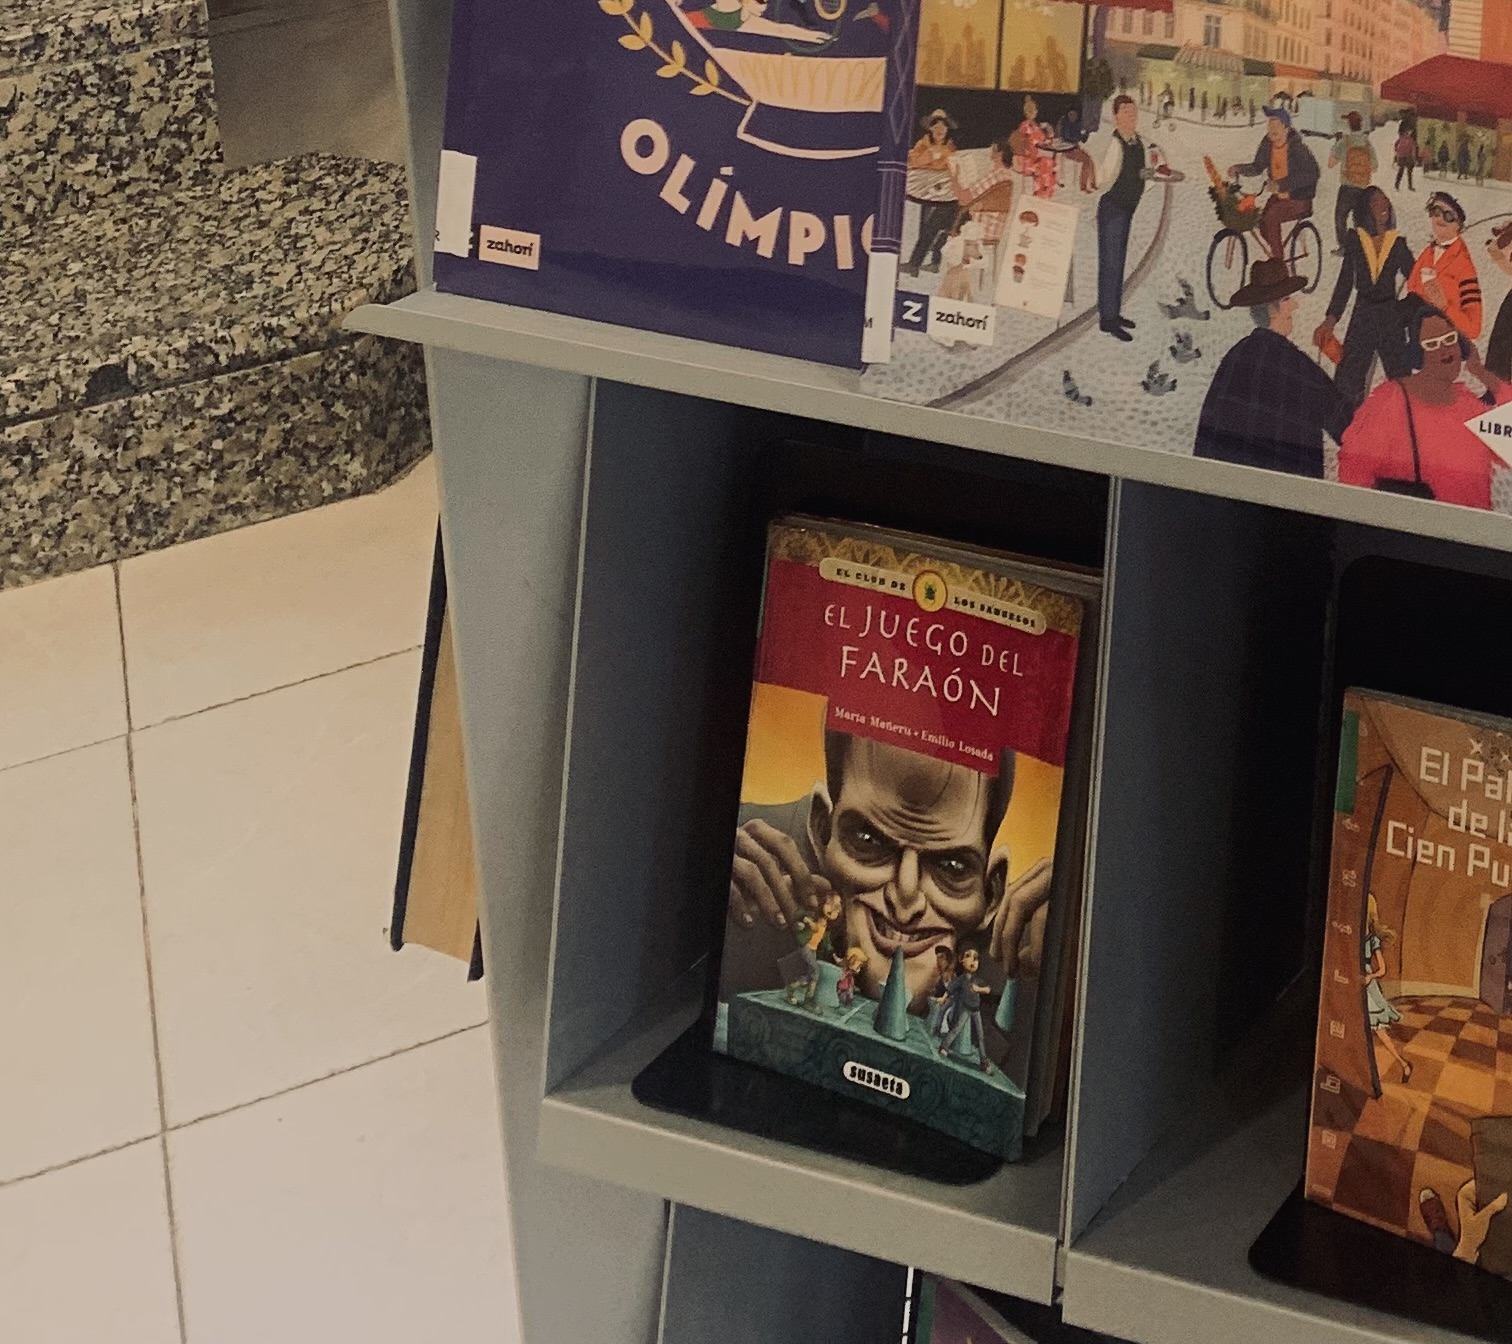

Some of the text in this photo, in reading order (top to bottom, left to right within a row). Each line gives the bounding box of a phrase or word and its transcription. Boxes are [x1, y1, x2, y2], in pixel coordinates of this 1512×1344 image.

[619, 118, 874, 270] OLÍMPI
[935, 310, 989, 331] zahorí
[835, 567, 851, 579] EL
[855, 572, 887, 587] CLUB
[890, 579, 907, 592] DE
[953, 596, 976, 610] LOS
[823, 603, 1024, 678] EL JUEGO DEL
[839, 645, 1001, 718] FARAÓN
[920, 729, 956, 750] Emilio
[1418, 745, 1451, 787] El
[1447, 798, 1490, 840] de
[1385, 819, 1457, 872] Cien
